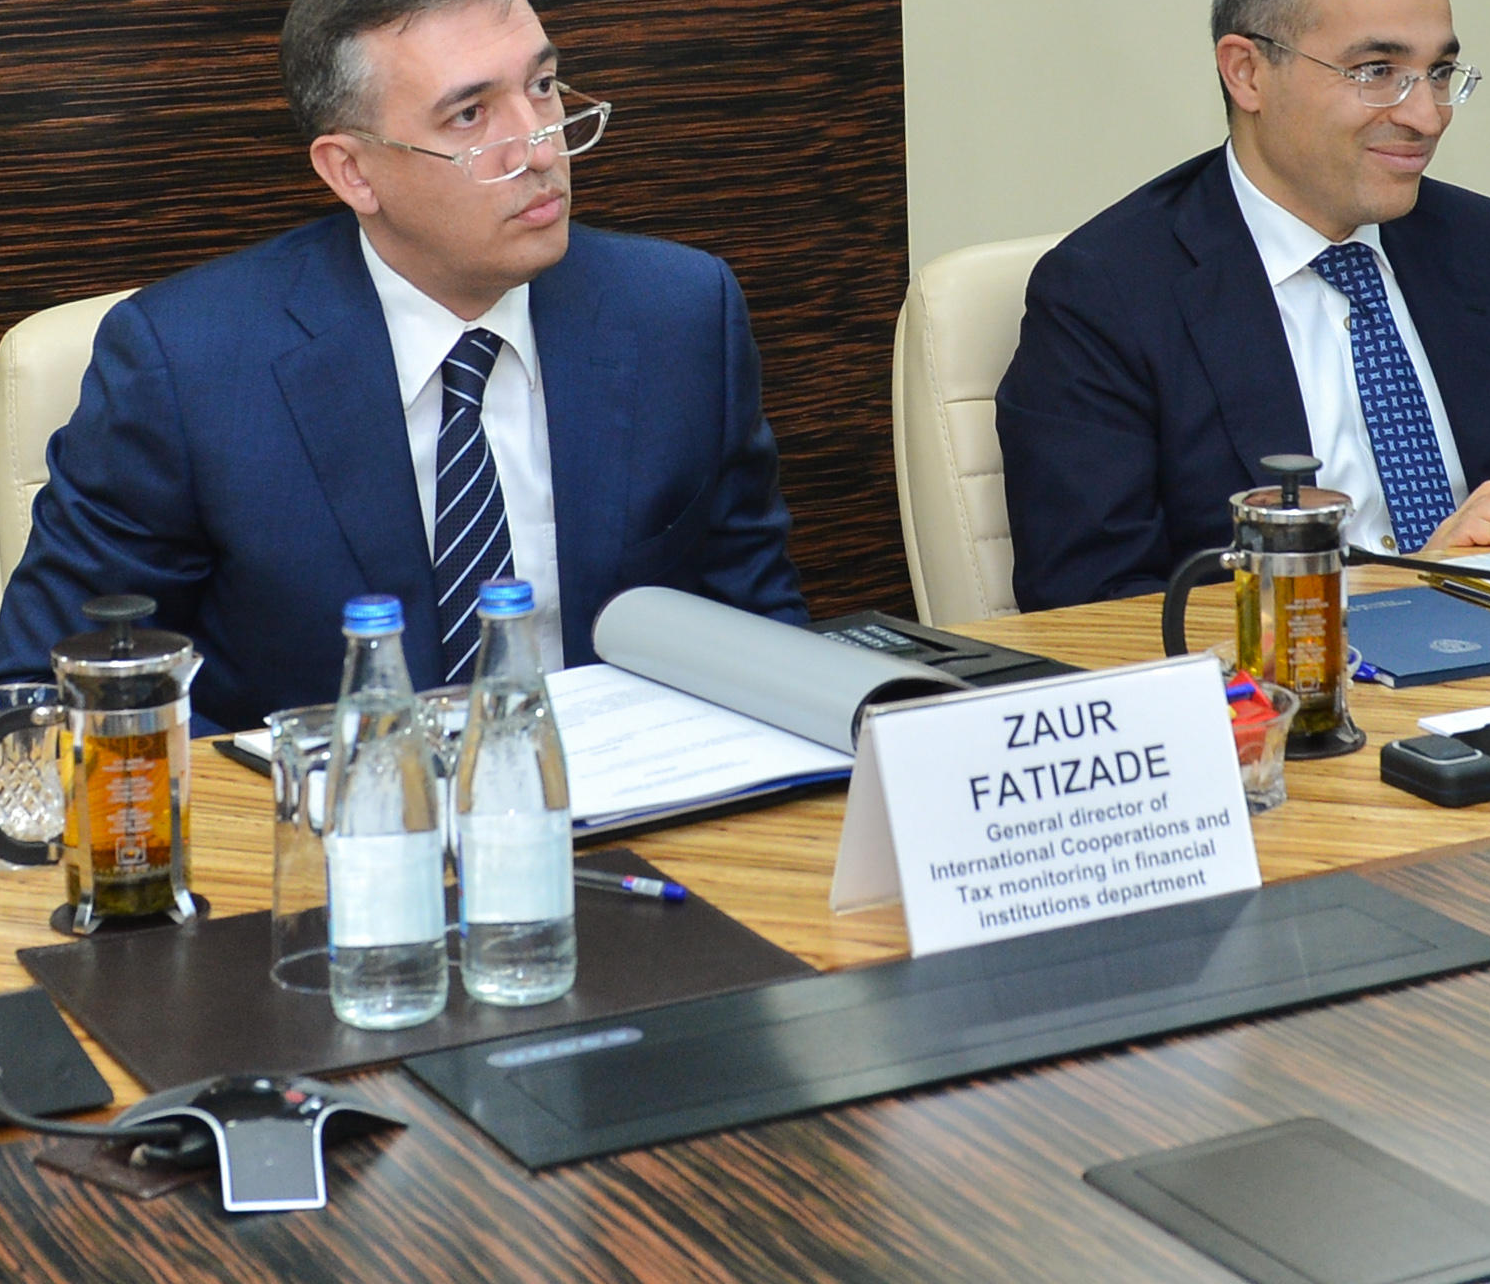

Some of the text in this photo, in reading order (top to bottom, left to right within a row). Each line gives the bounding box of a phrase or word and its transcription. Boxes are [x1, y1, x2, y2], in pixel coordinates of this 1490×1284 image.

[1003, 699, 1117, 750] ZAUR
[969, 744, 1171, 811] FATIZADE
[930, 809, 1230, 882] International Cooperations and
[986, 792, 1169, 843] General director of
[957, 839, 1216, 904] Tax monitoring in financial
[979, 870, 1207, 929] institutions department
